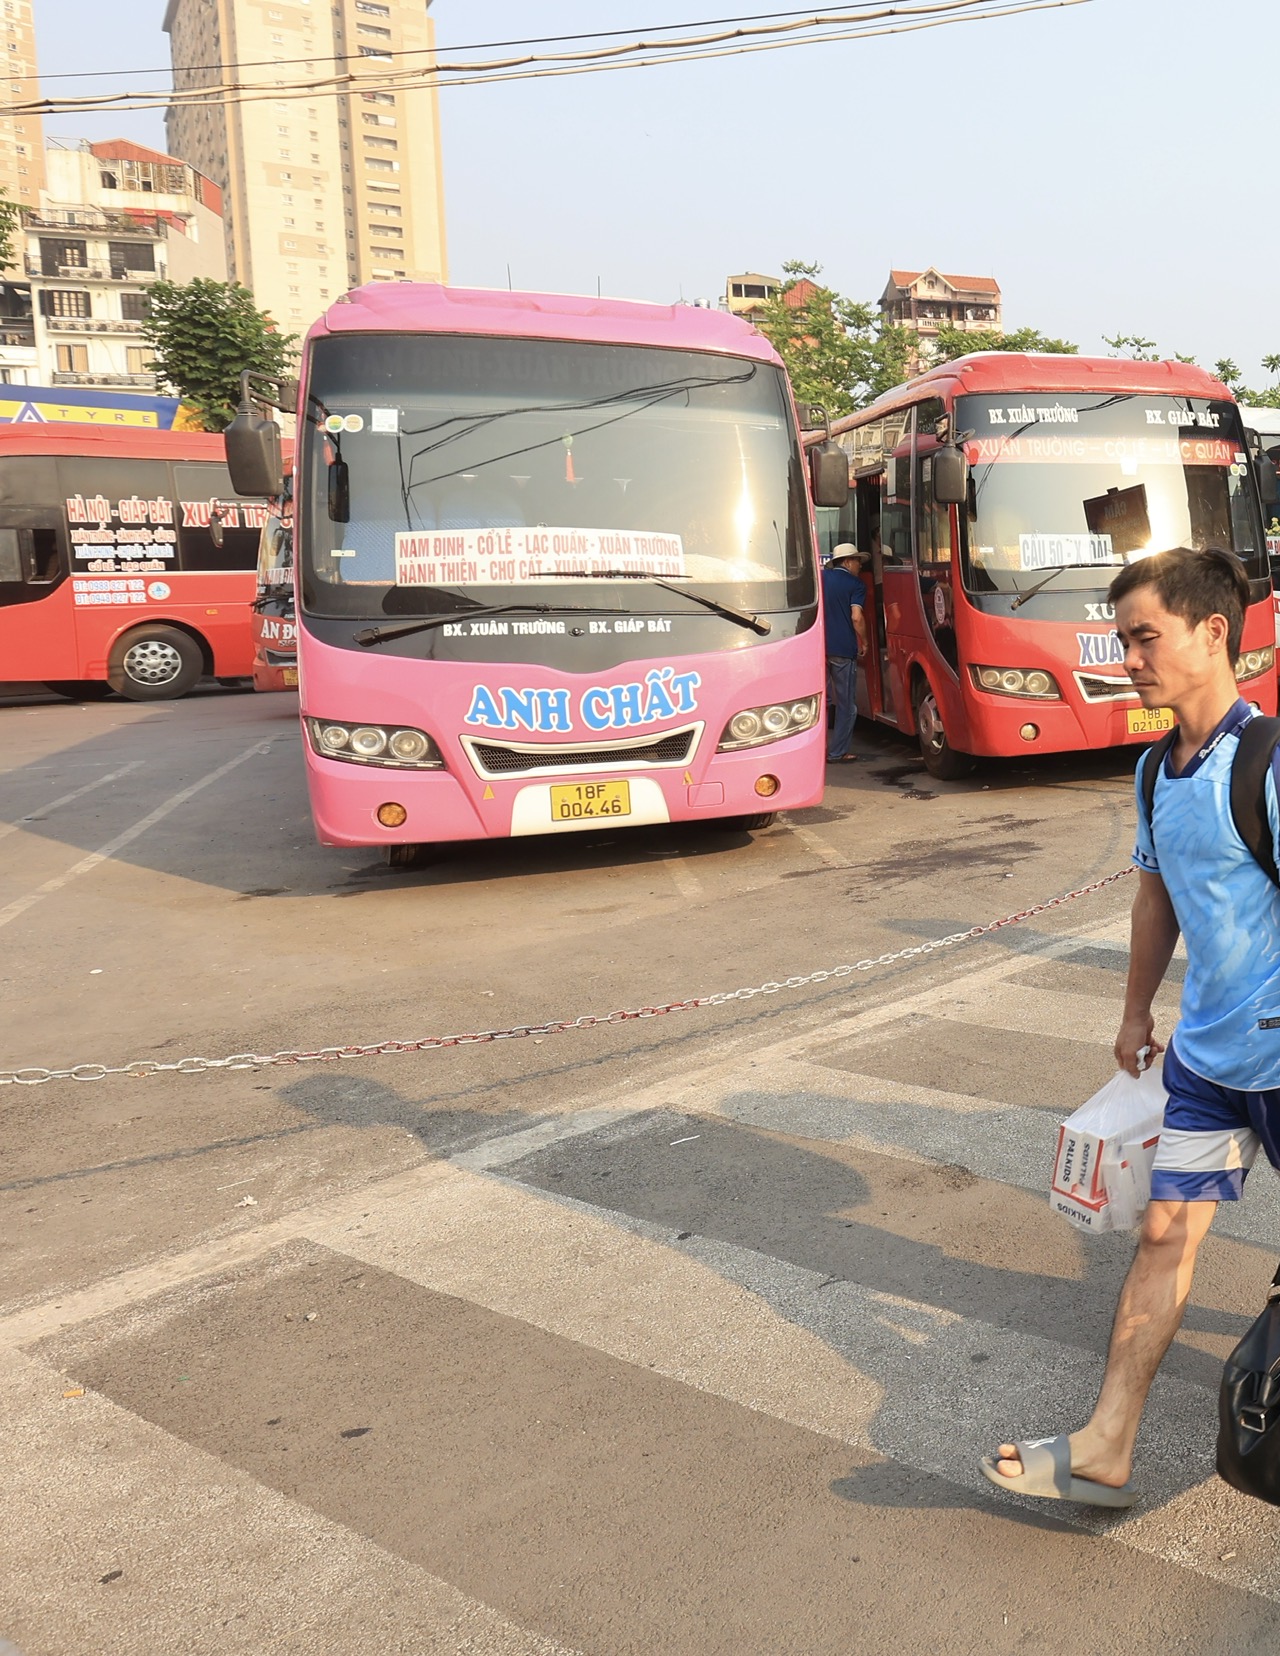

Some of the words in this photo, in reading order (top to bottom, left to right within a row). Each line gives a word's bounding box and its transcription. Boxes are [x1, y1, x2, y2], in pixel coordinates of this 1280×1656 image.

[58, 409, 151, 423] TYRE
[1008, 404, 1036, 423] XUÂN
[1036, 403, 1079, 424] TRƯỜNG
[1168, 407, 1197, 427] GIÁP
[1198, 409, 1220, 428] BÁT
[67, 494, 88, 523] HÀ
[119, 496, 148, 523] GIÁP
[148, 496, 173, 523] BÁT
[400, 538, 429, 558] NAM
[433, 536, 465, 560] ĐỊNH
[477, 529, 494, 555] CỔ
[496, 529, 512, 554] LỄ
[525, 534, 549, 557] LẠC
[553, 530, 587, 556] QUẦN
[598, 533, 632, 555] XUÂN
[633, 535, 680, 557] TRƯỜNG
[1049, 539, 1063, 566] 50
[399, 560, 436, 584] HÀNH
[440, 558, 477, 585] THIỆN
[490, 559, 516, 584] CHỢ
[519, 556, 543, 580] CÁT
[554, 557, 588, 580] XUÂN
[622, 557, 655, 580] XUÂN
[260, 618, 280, 640] AN
[443, 622, 467, 637] BX.
[470, 620, 509, 636] XUÂN
[511, 618, 566, 635] TRƯỜNG
[589, 620, 612, 634] BX.
[614, 618, 645, 633] GIÁP
[649, 618, 672, 633] BÁT
[1076, 630, 1125, 666] XUÂ
[464, 684, 573, 733] ANH
[580, 666, 702, 731] CHẤT
[1142, 708, 1161, 720] 18B
[1133, 719, 1170, 732] 021.03
[575, 784, 606, 801] 18F
[560, 799, 622, 818] 004.46
[1063, 1138, 1076, 1183] PALKIDS
[1057, 1202, 1092, 1225] PALKIDS
